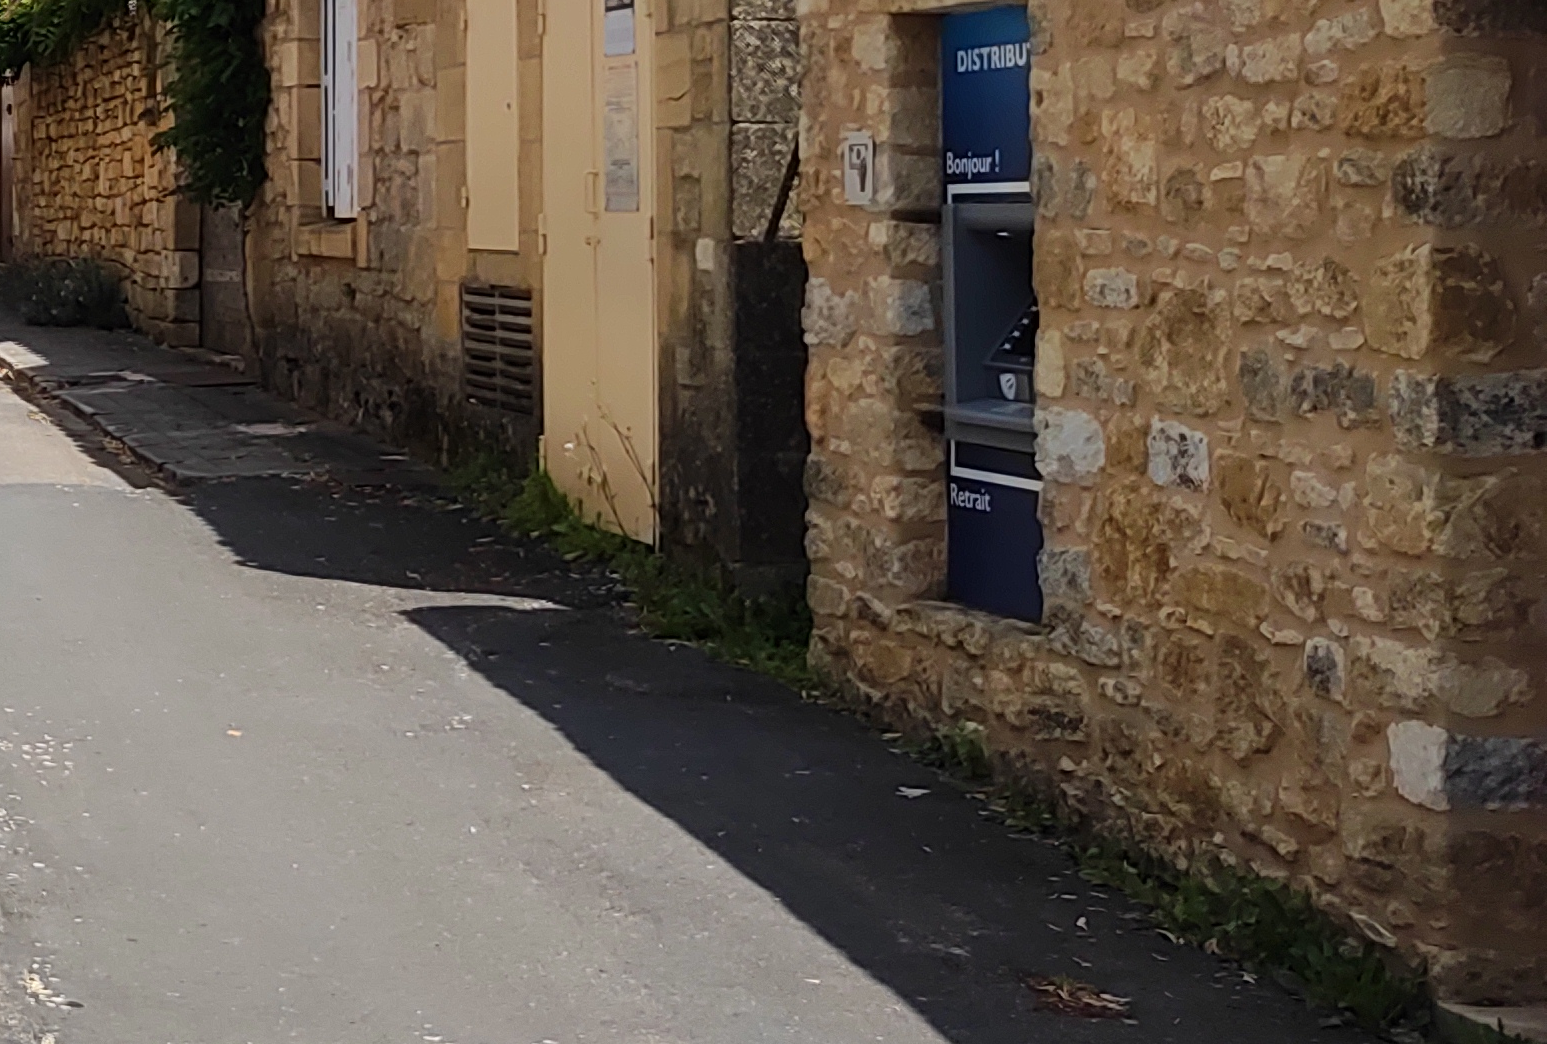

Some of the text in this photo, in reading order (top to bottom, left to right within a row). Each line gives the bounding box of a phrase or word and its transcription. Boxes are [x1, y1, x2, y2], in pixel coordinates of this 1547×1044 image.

[956, 41, 1031, 73] DISTRIBU
[946, 151, 992, 180] Bonjour
[949, 482, 992, 513] Retrait
